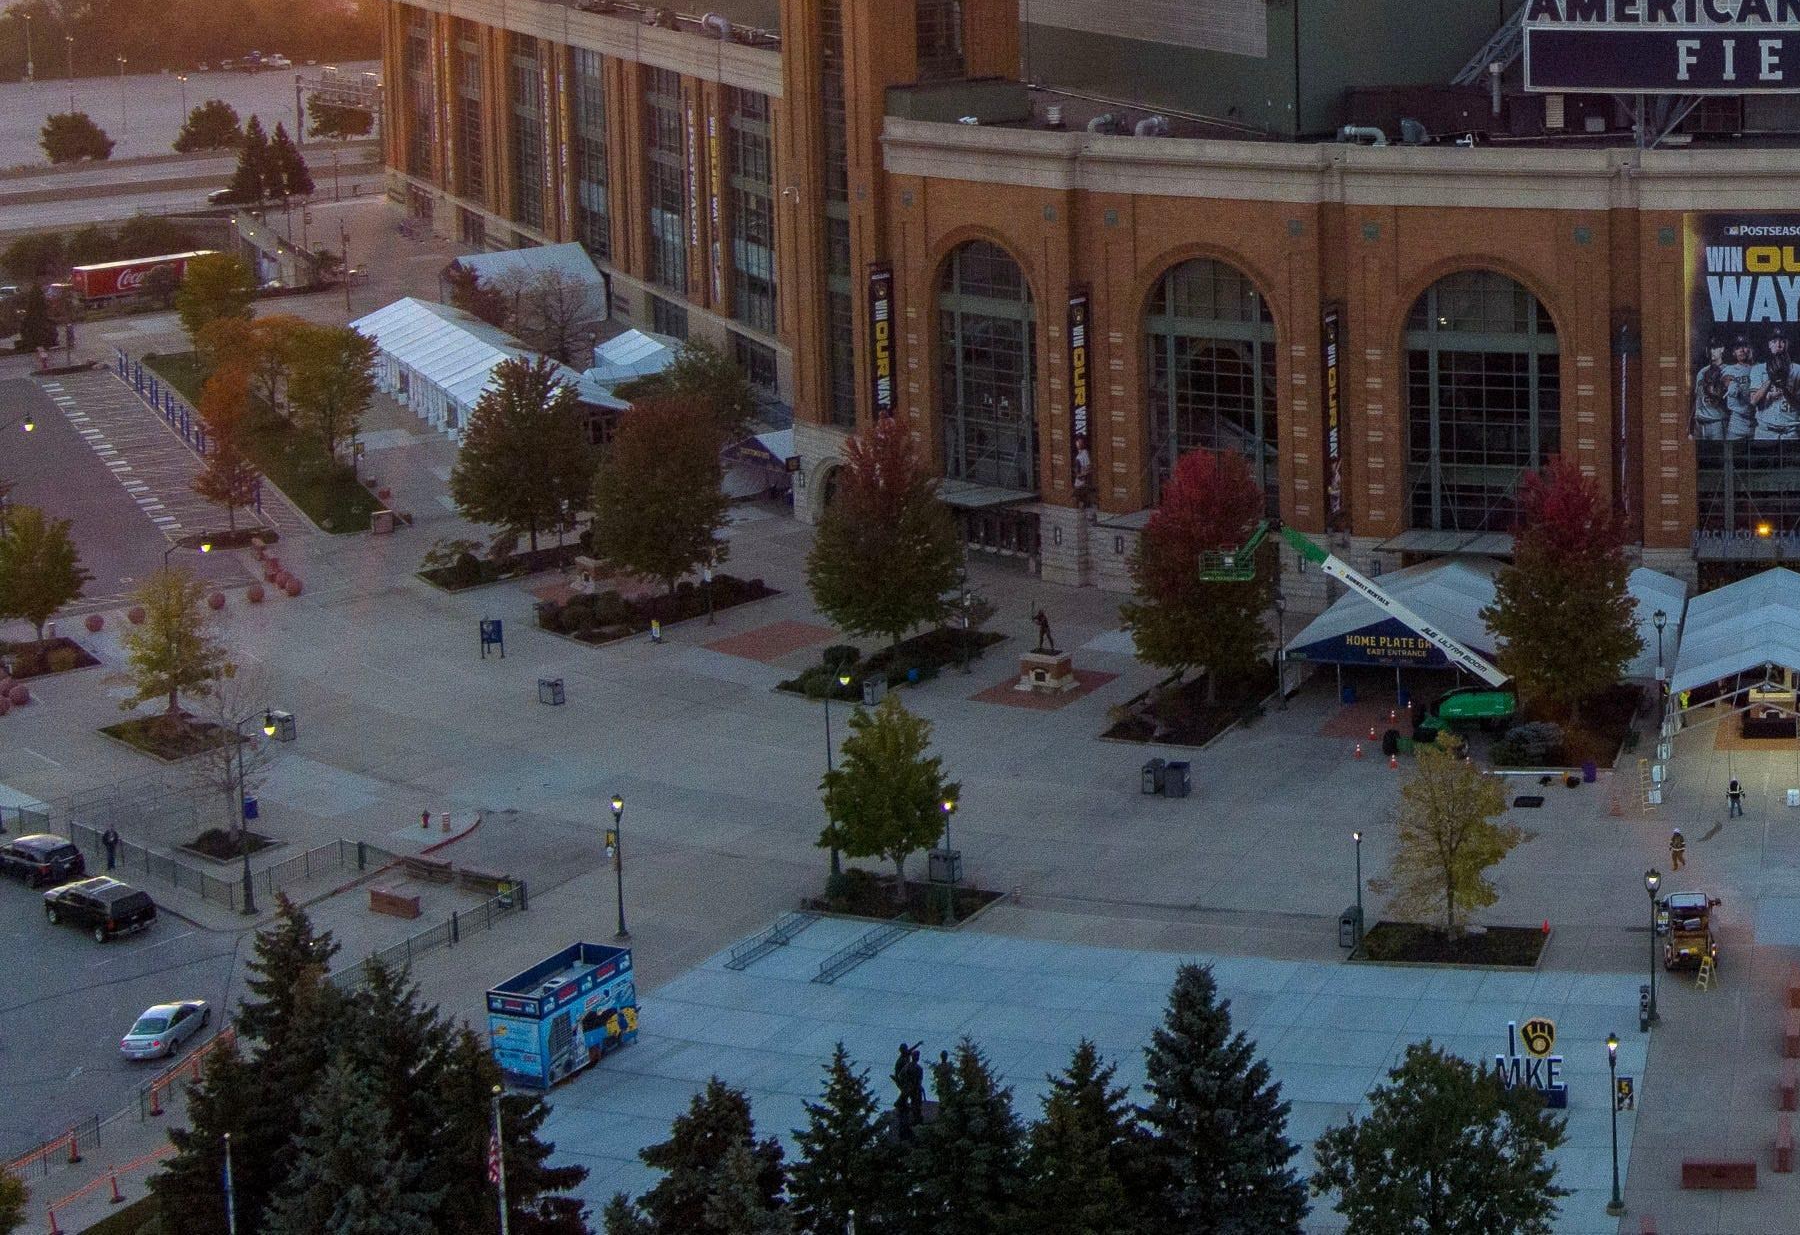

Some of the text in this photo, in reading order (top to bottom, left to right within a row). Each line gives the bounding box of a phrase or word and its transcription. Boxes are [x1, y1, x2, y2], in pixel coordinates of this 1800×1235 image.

[1705, 246, 1743, 272] WIN
[874, 299, 891, 407] WIN OUR WAY
[1072, 324, 1088, 436] WIN OUR WAY
[1345, 635, 1440, 650] HOME PLATE GA
[1366, 648, 1427, 658] EAST ENTRANCE
[1437, 637, 1464, 657] ULTRA
[1495, 1054, 1565, 1091] MKE
